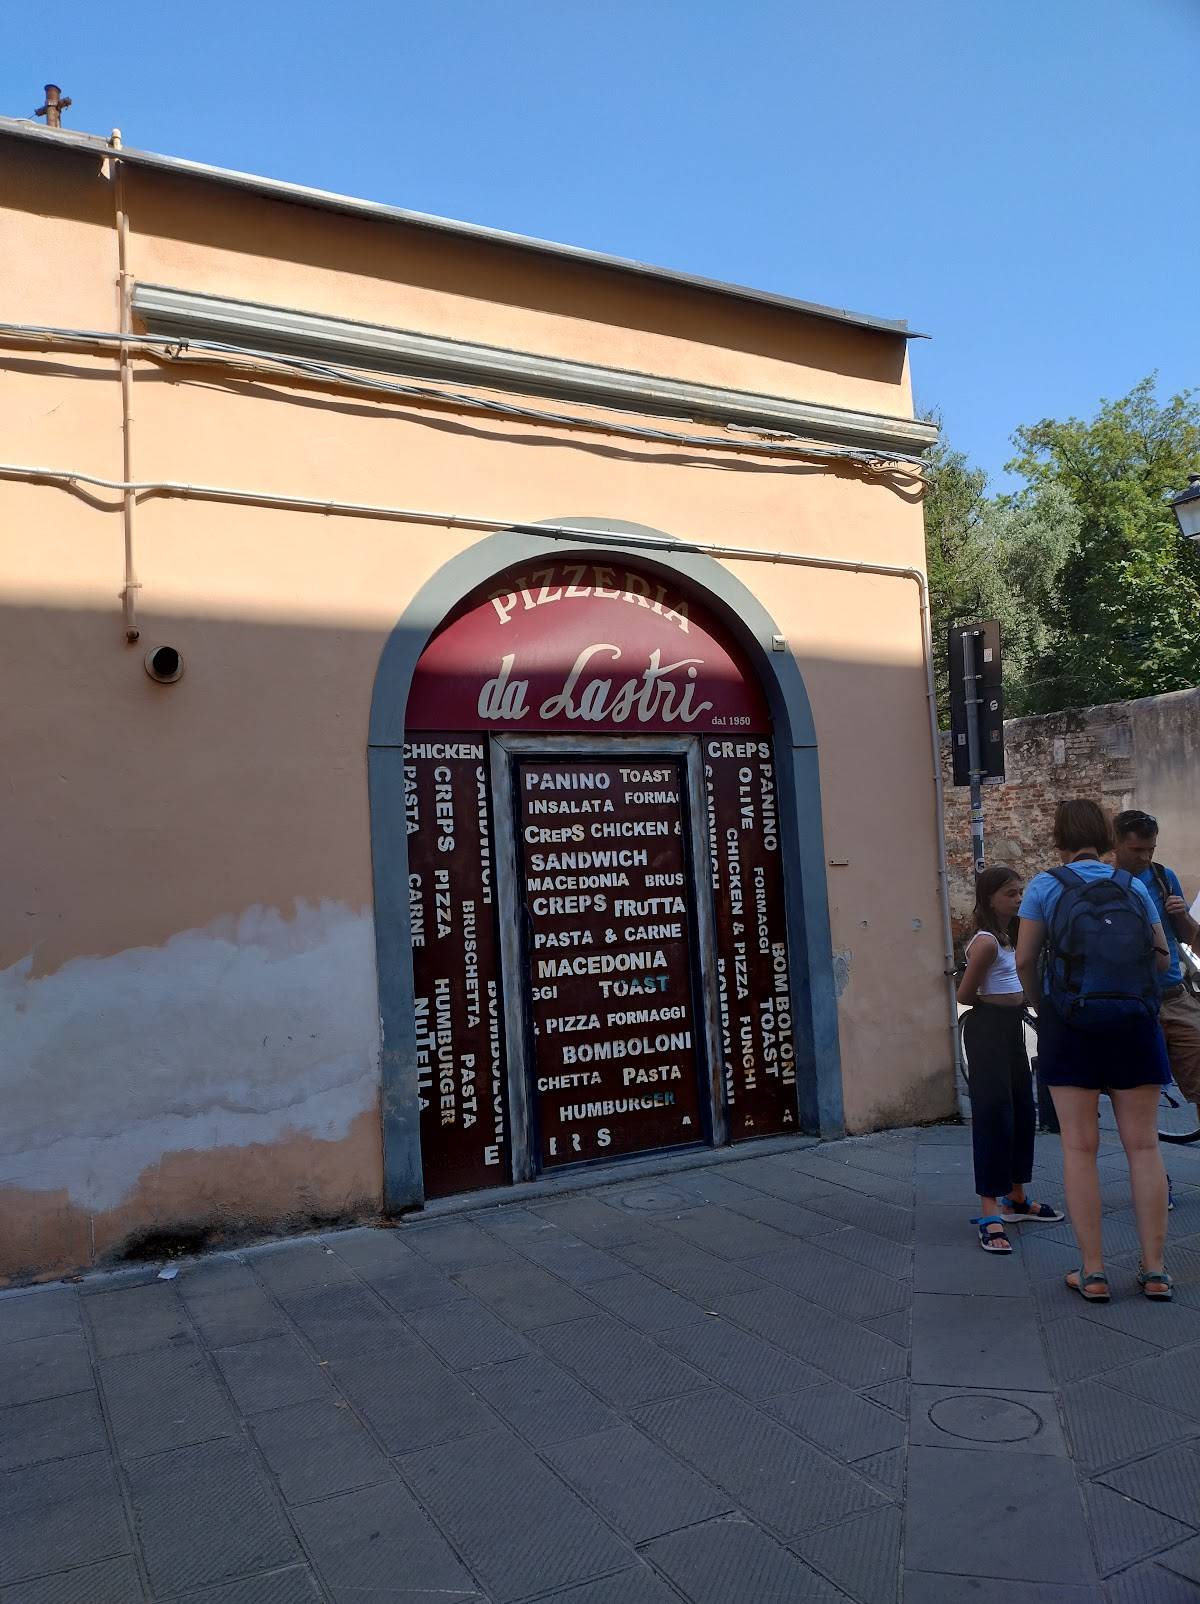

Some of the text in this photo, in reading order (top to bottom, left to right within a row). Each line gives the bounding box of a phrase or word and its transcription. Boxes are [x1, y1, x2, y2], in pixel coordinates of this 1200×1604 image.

[488, 565, 690, 633] PIZZERIA
[478, 643, 713, 723] da Lastri
[711, 716, 751, 726] dal 1950
[402, 744, 484, 759] CHICKEN
[708, 742, 770, 758] CREPS
[404, 766, 420, 835] PASTA
[526, 768, 672, 790] PANINO TOAST
[528, 791, 680, 814] INSALATA FORMA
[738, 767, 754, 830] OLIVE
[434, 766, 455, 852] CREPS
[760, 764, 778, 851] PANINO
[524, 824, 585, 844] CREPS
[591, 821, 669, 838] CHICKEN
[528, 872, 684, 892] MACEDONIA BRUS
[531, 850, 648, 872] SANDWICH
[408, 873, 425, 947] CARNE
[434, 870, 452, 939] PIZZA
[532, 894, 686, 918] CREPS FRUTTA
[726, 828, 748, 1000] CHICKEN & PIZZA
[754, 866, 770, 954] FORMAGGI
[534, 924, 682, 948] PASTA & CARNE
[462, 900, 480, 1028] BRUSCHETTA
[538, 950, 668, 979] MACEDONIA
[598, 975, 670, 998] TOAST
[546, 1014, 600, 1034] PIZZA
[607, 1006, 686, 1026] FORMAGGI
[772, 942, 796, 1085] BOMBOLONI
[434, 978, 456, 1126] HUMBURGER
[562, 1032, 692, 1064] BOMBOLONI
[740, 1016, 756, 1090] FUNGHI
[760, 997, 778, 1078] TOAST
[460, 1054, 477, 1128] PASTA
[537, 1065, 682, 1092] CHETTA PASTA
[560, 1091, 676, 1122] HUMBURGER
